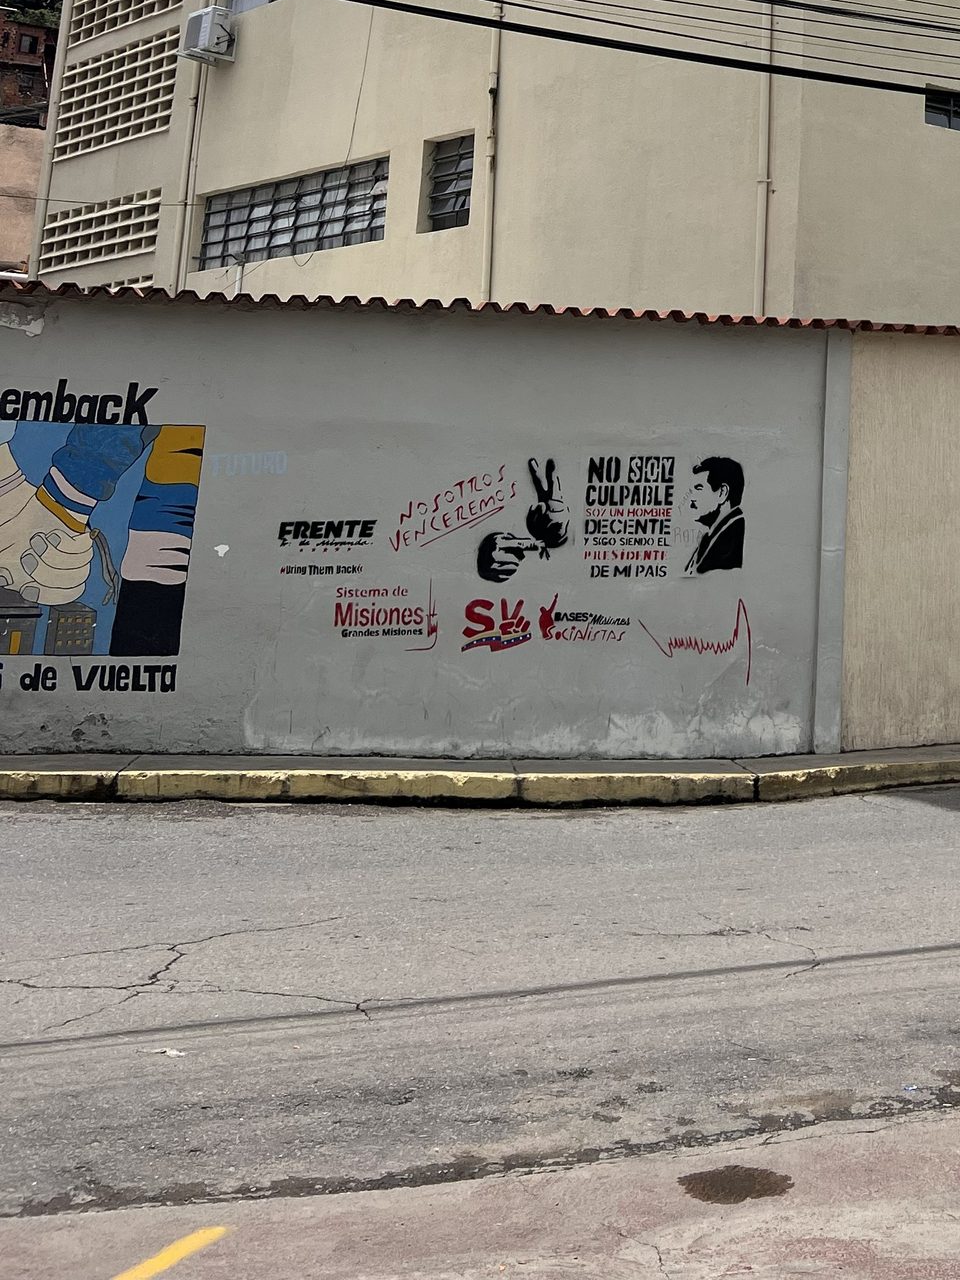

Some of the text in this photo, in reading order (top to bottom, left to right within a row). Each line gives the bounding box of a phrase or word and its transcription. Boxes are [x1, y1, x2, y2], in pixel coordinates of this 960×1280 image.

[587, 457, 675, 483] NO SOY
[400, 465, 505, 524] NOSOTROS
[585, 485, 674, 507] CULPABLE
[389, 481, 517, 552] VENCEREMOS
[585, 508, 672, 518] SOY UN HOMBRE
[278, 520, 377, 540] FRENTE
[584, 519, 672, 535] DECENTE
[584, 537, 590, 547] Y
[619, 537, 655, 547] SIENDO
[657, 537, 671, 547] EL
[590, 565, 609, 578] DE
[336, 586, 408, 598] Sistema de
[334, 602, 424, 627] Misiones
[341, 628, 423, 638] Grandes Misiones
[20, 663, 57, 692] de
